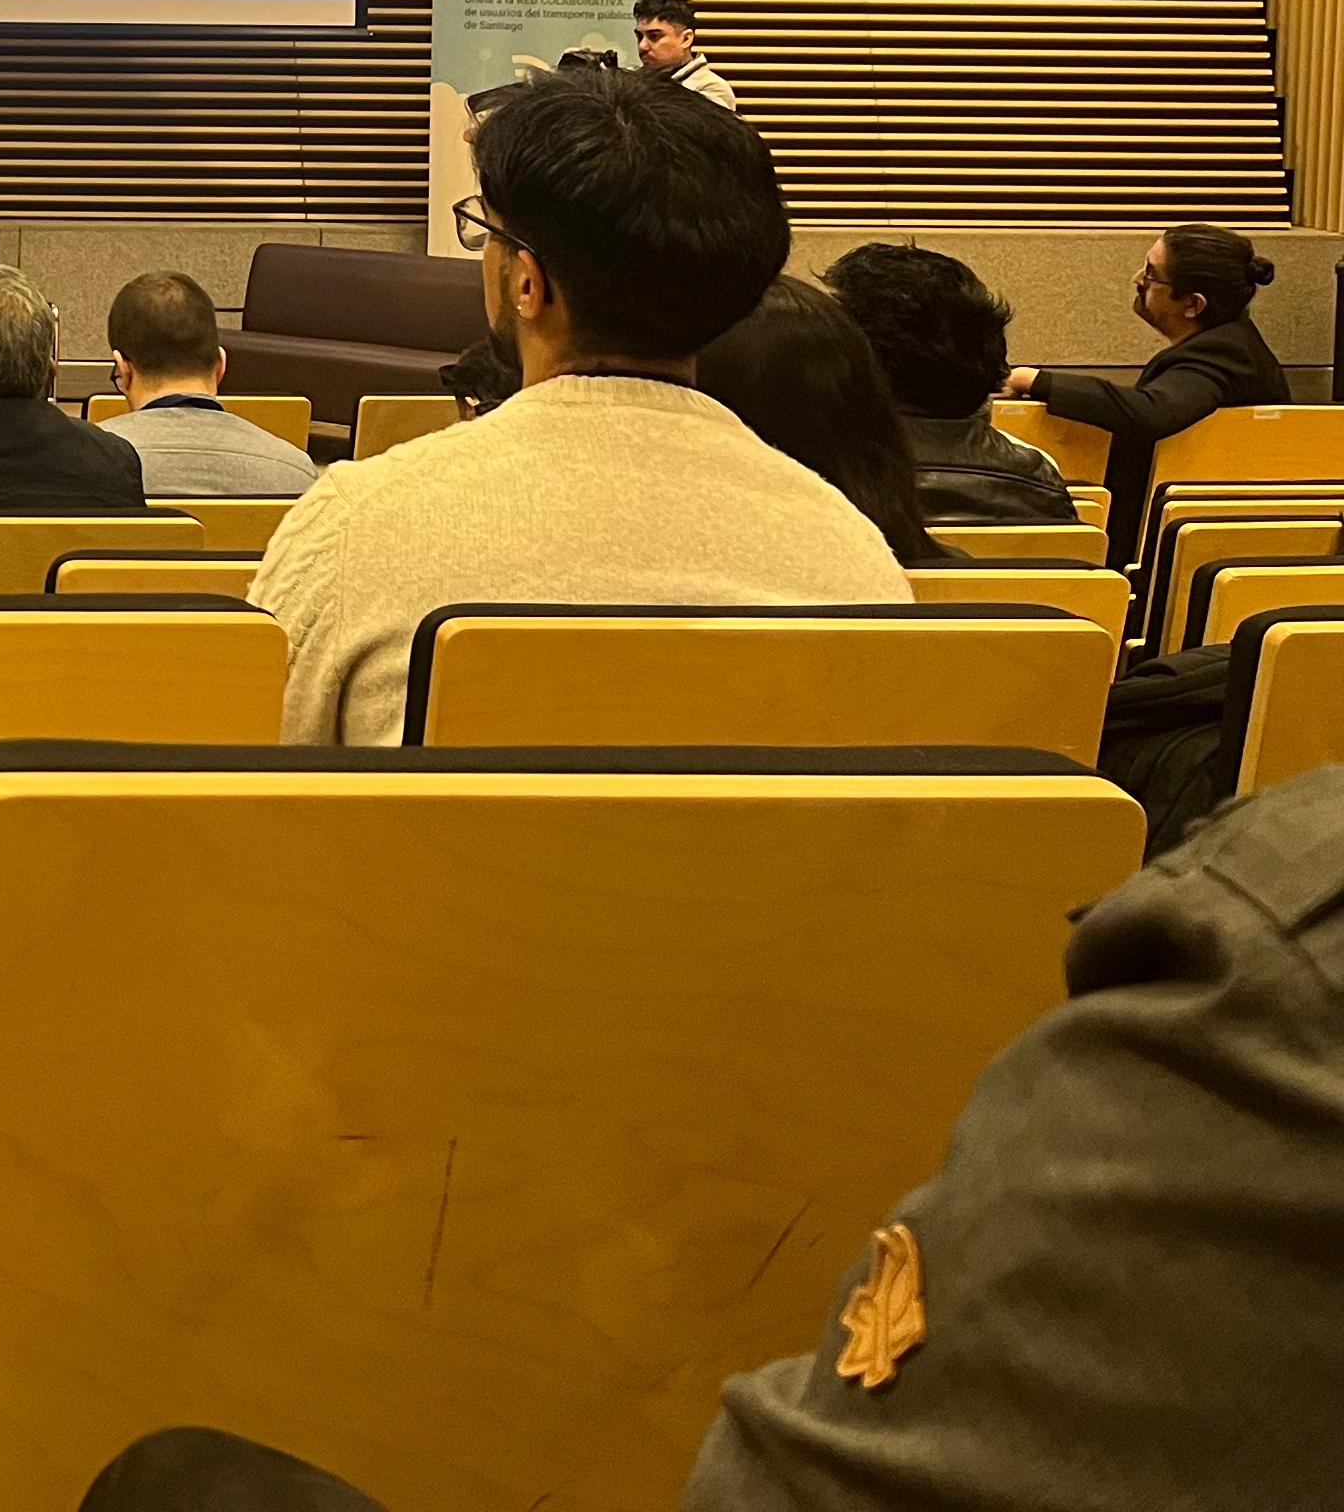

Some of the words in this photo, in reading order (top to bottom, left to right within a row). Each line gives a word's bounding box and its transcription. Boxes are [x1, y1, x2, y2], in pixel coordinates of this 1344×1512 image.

[464, 7, 478, 17] de
[479, 8, 522, 18] usuarios
[525, 8, 541, 18] del
[542, 8, 595, 20] transporte
[463, 21, 478, 31] de
[479, 20, 524, 33] Santiago
